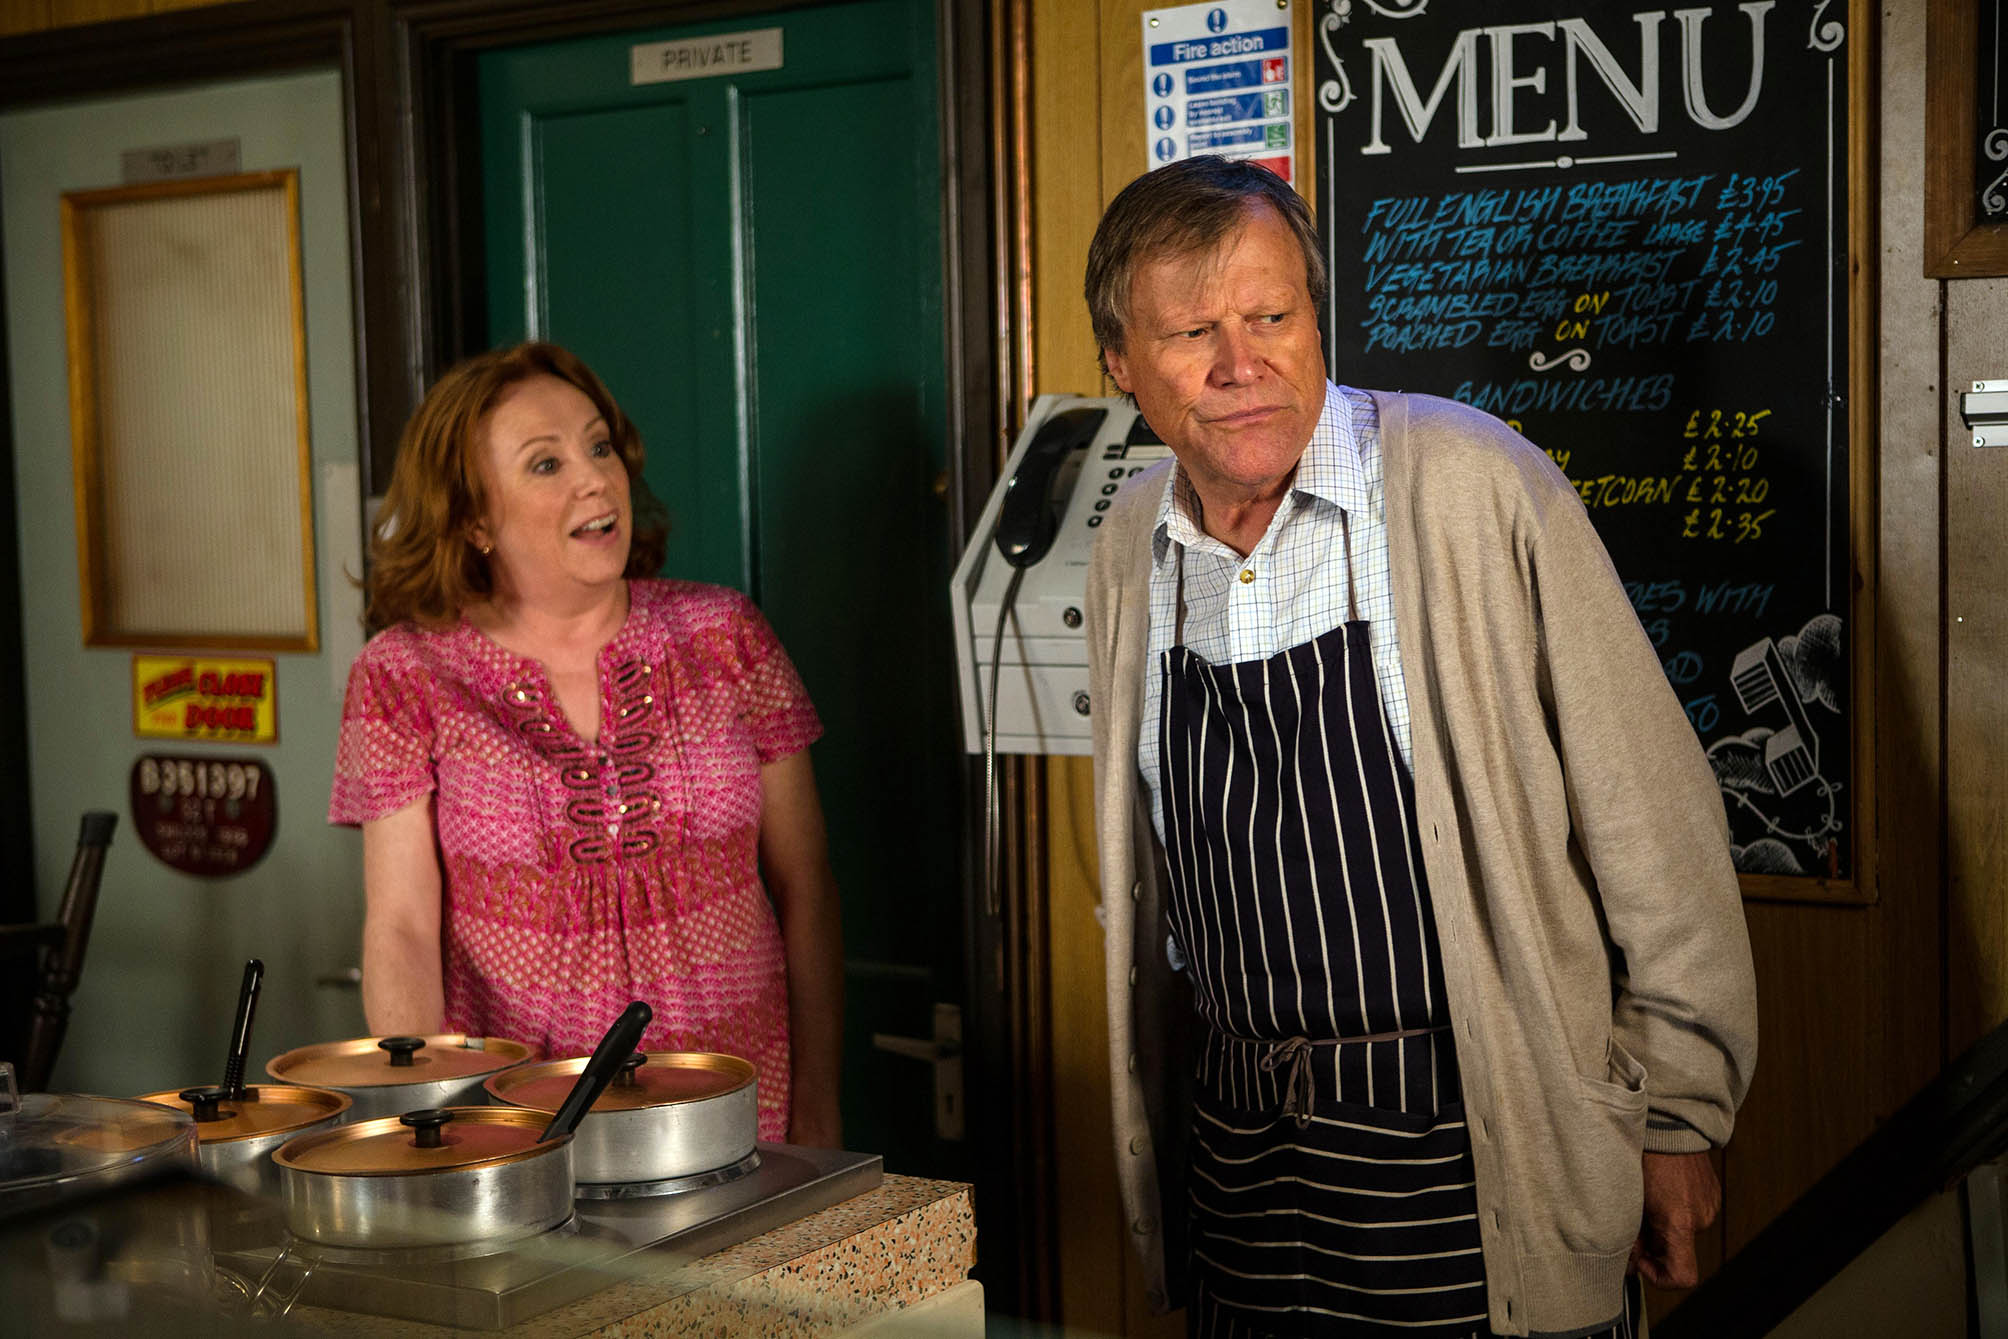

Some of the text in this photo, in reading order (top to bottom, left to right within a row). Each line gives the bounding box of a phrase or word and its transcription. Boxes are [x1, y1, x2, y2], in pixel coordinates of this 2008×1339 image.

[663, 40, 752, 70] PRIVATE
[1172, 35, 1264, 61] Fire action
[1362, 1, 1775, 154] MENU
[1362, 196, 1430, 234] FULL
[1429, 187, 1562, 231] ENGLISH
[1561, 173, 1716, 224] BREAKFAST
[1362, 229, 1443, 263] WITH
[1446, 225, 1496, 258] TEA
[1496, 223, 1534, 253] OR
[1537, 219, 1639, 251] COFFEE
[1643, 219, 1708, 246] LARGE
[1364, 255, 1531, 294] VEGETARIAN
[1527, 249, 1687, 290] BREAKFAST
[1360, 293, 1519, 328] SCRAMBLED
[1518, 288, 1570, 320] EGG
[1574, 291, 1610, 315] ON
[1613, 279, 1701, 316] TOAST
[1364, 320, 1482, 353] POACHED
[1487, 320, 1542, 351] EGG
[1555, 320, 1590, 341] ON
[1594, 312, 1684, 349] TOAST
[1452, 373, 1676, 413] SANDWICHES
[1696, 580, 1776, 618] WITH
